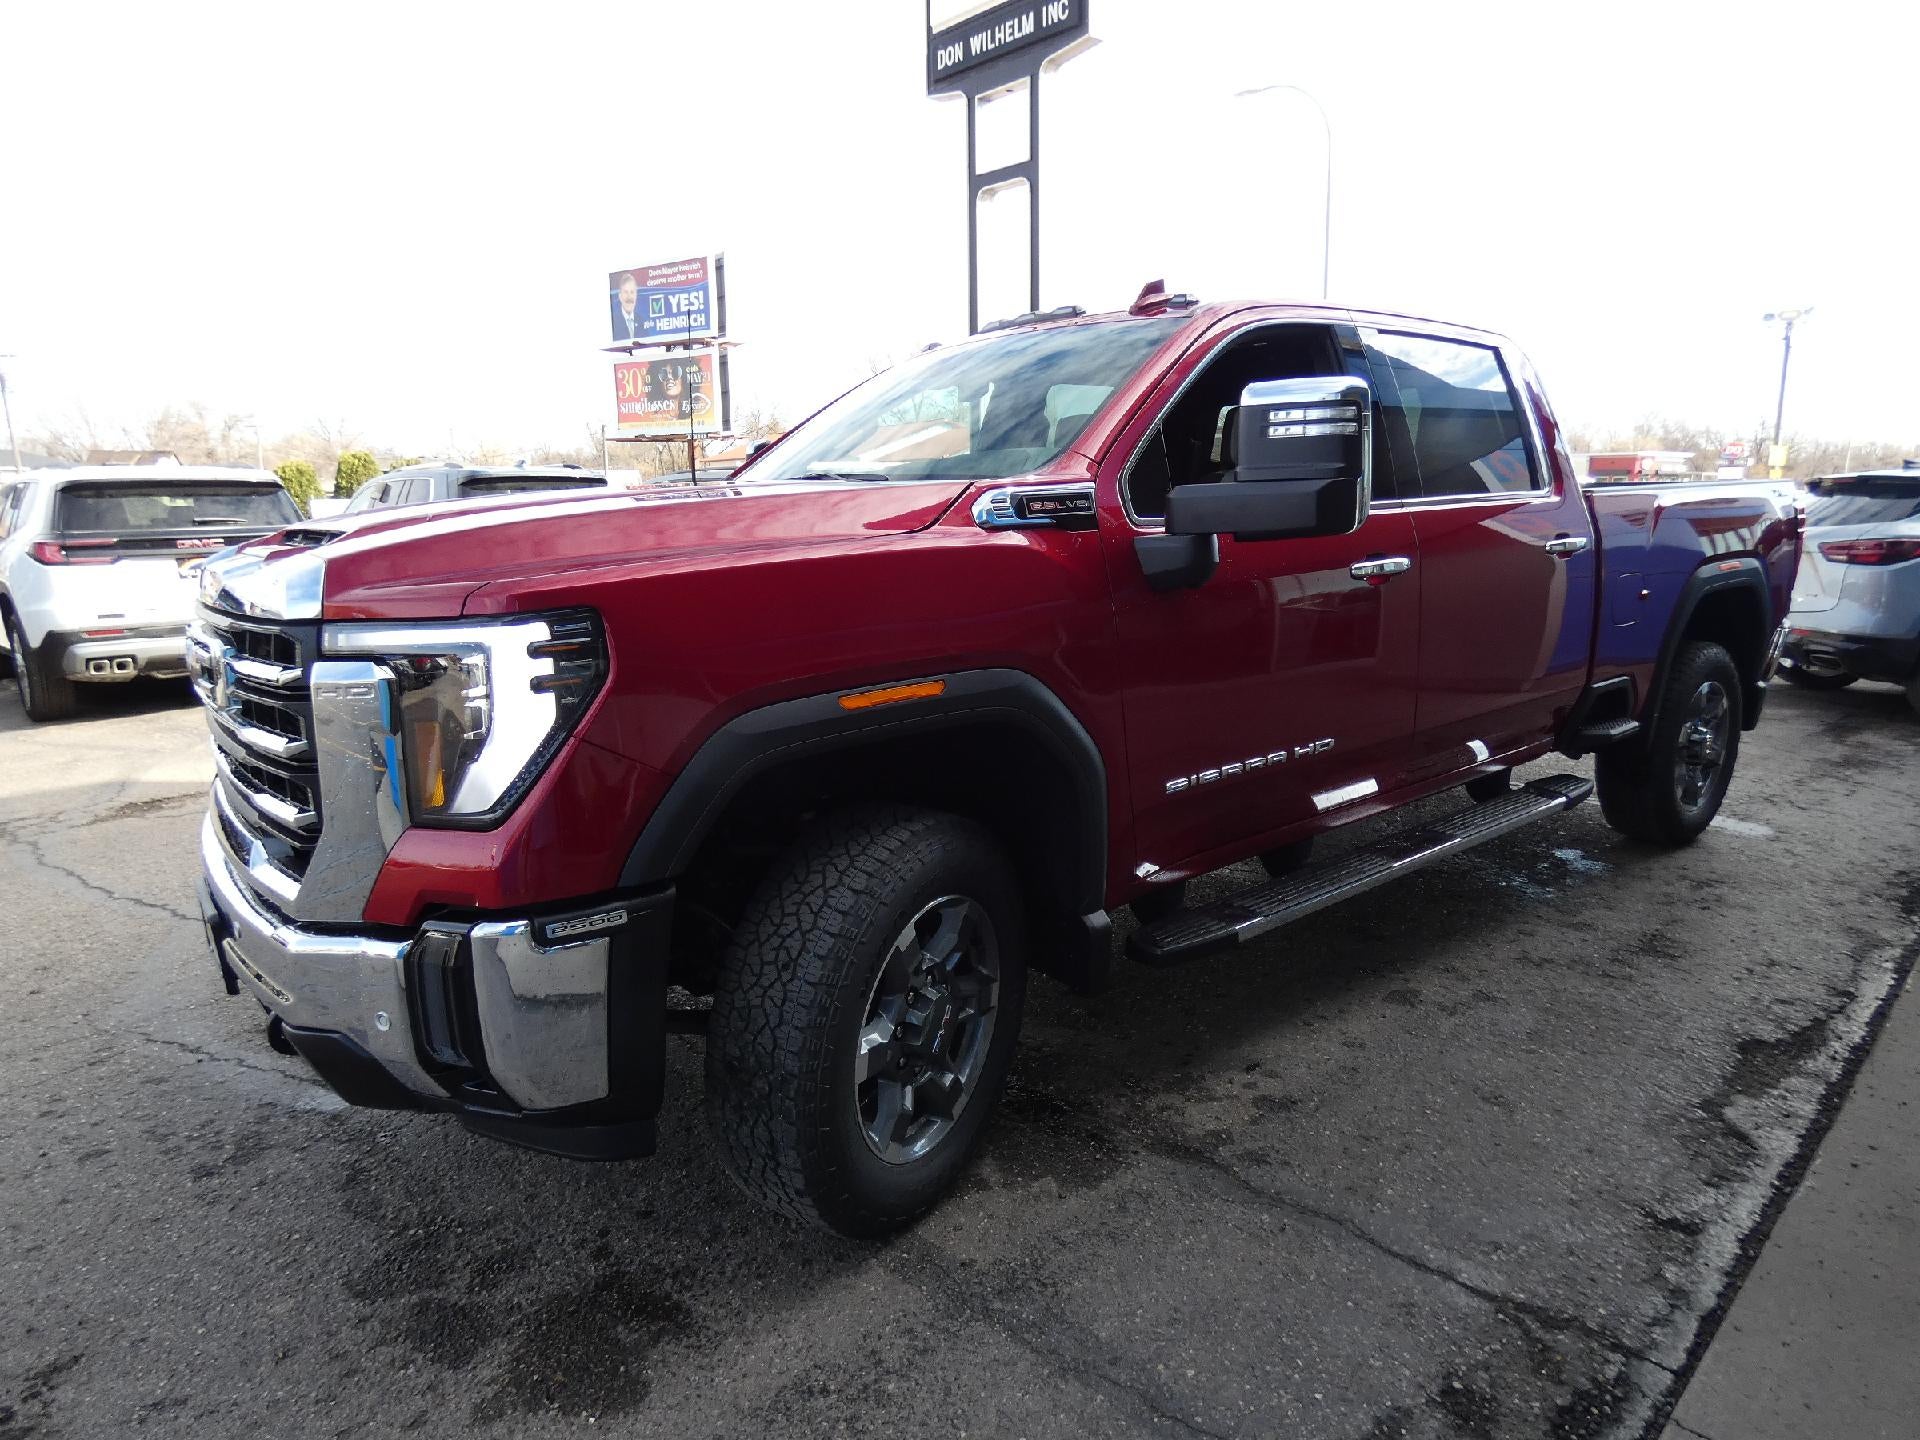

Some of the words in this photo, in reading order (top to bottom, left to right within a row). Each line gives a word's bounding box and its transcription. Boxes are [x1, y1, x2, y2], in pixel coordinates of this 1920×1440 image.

[937, 41, 964, 70] DON
[970, 12, 1034, 56] WILHELM
[1042, 0, 1069, 28] INC
[668, 291, 704, 313] YES!
[656, 313, 705, 331] HEINRICH
[176, 538, 225, 549] GMC
[1166, 751, 1287, 793] SIERRA
[1294, 738, 1335, 759] HD
